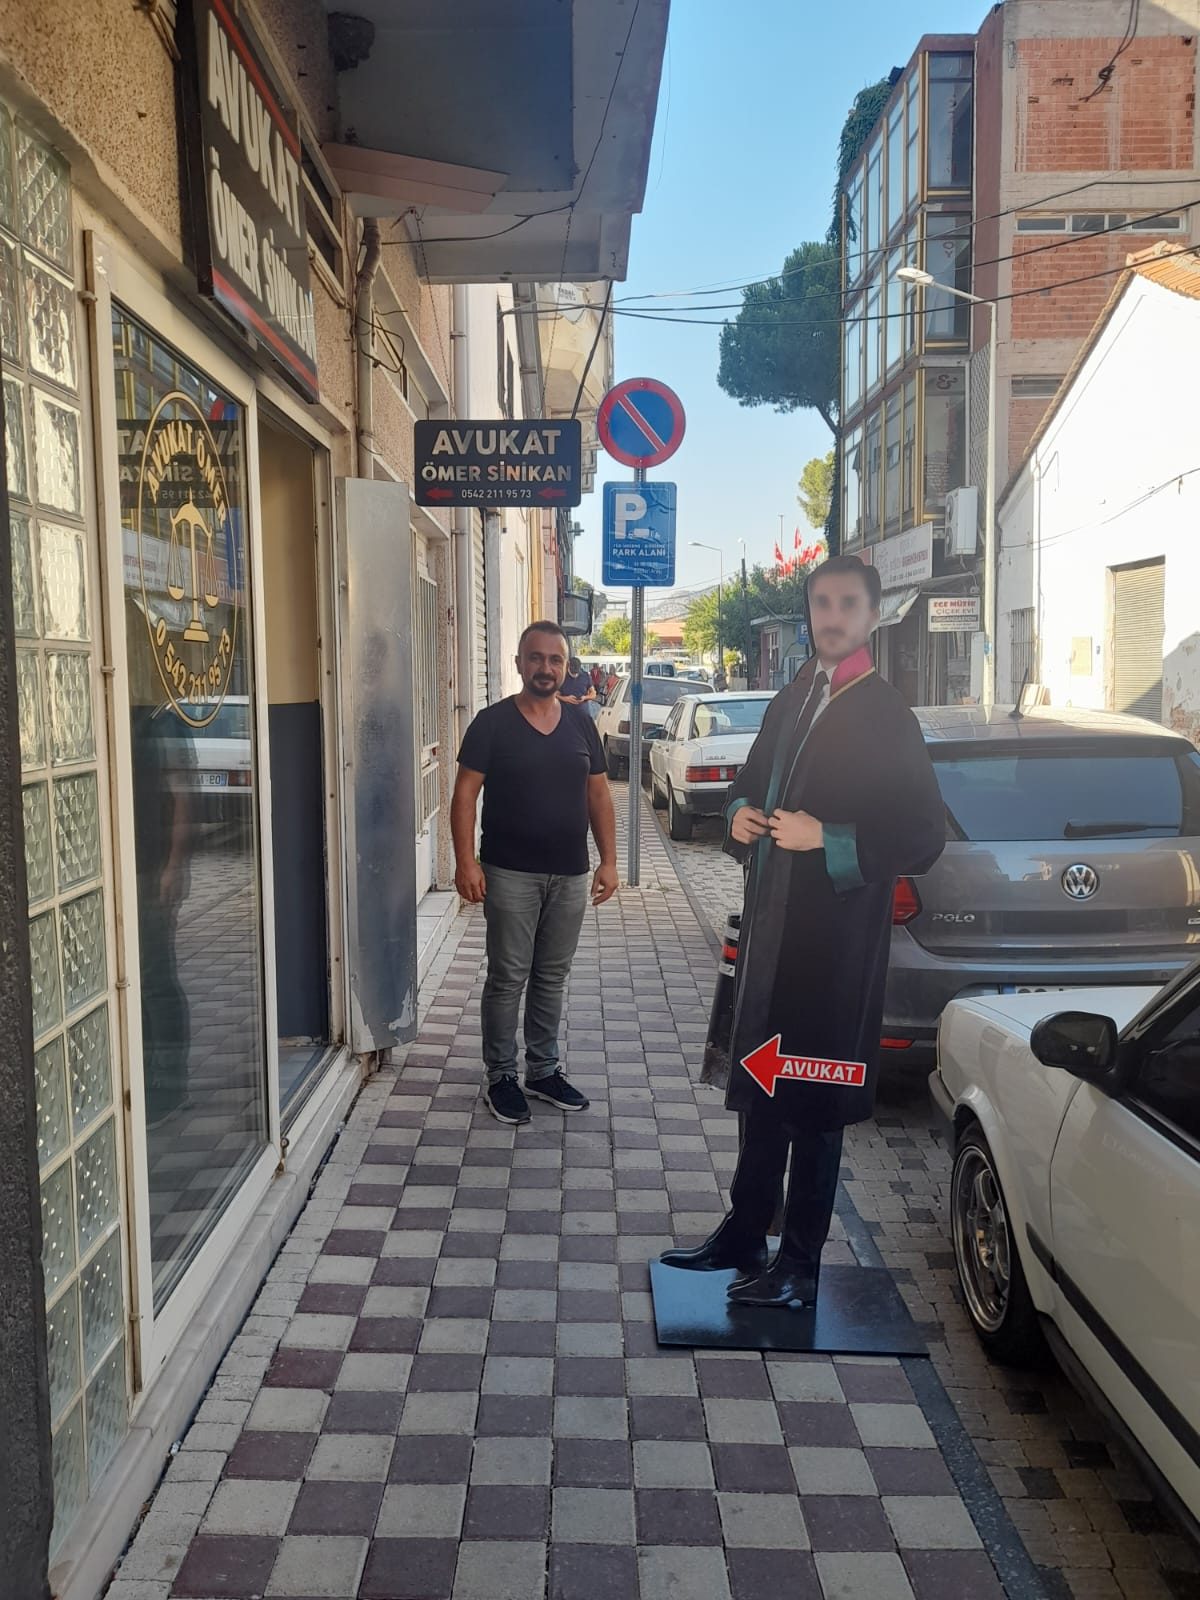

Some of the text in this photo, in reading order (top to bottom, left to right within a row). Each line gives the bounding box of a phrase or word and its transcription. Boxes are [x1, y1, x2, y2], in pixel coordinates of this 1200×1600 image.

[208, 9, 300, 239] AVUKAT
[210, 146, 263, 302] ÖMER
[432, 430, 561, 455] AVUKAT
[147, 420, 227, 528] AVUKAT ÖMER
[421, 461, 571, 481] ÖMER SİNİKAN
[461, 489, 532, 498] 0542 211 95 73
[614, 493, 647, 540] P
[613, 548, 637, 557] PARK
[156, 618, 231, 704] 0 542 211 95 73
[932, 913, 976, 923] POLO
[780, 1059, 857, 1081] AVUKAT
